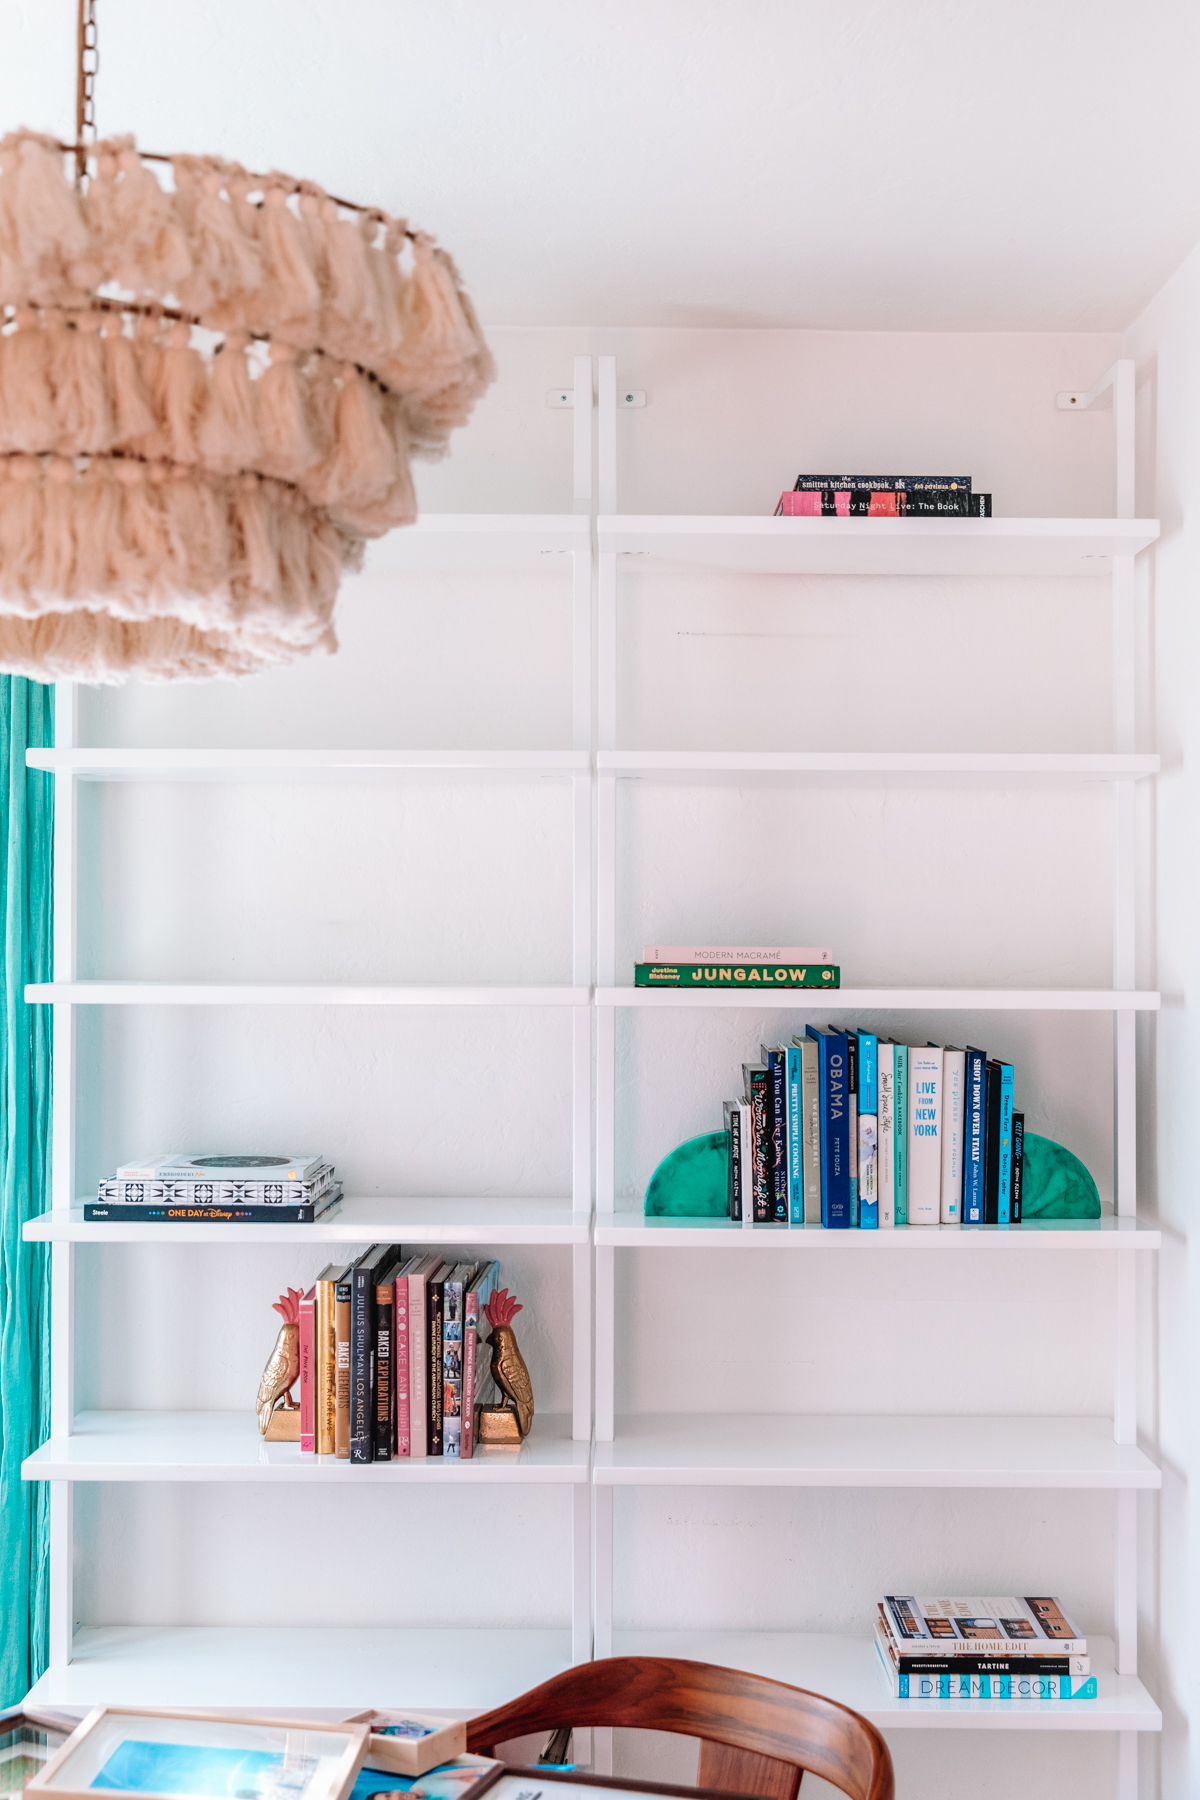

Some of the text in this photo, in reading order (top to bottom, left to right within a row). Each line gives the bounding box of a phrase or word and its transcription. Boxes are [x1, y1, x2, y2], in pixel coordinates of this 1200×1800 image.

[814, 502, 856, 510] Saturday
[890, 503, 915, 511] Live:
[736, 950, 781, 960] MACRAMÉ
[692, 968, 807, 981] JUNGALOW
[774, 1063, 782, 1076] All
[973, 1058, 981, 1082] SHOT
[830, 1054, 843, 1120] OBAMA
[916, 1082, 936, 1094] LIVE
[973, 1084, 981, 1110] DOWN
[754, 1093, 764, 1130] Woven
[879, 1072, 893, 1133] Small Space Style
[915, 1109, 936, 1120] NEW
[913, 1125, 937, 1136] YORK
[972, 1112, 980, 1135] OVER
[754, 1148, 767, 1207] Moonlight
[168, 1209, 187, 1217] ONE
[187, 1209, 203, 1217] DAY
[208, 1208, 232, 1220] Disney
[398, 1300, 406, 1331] COCO
[398, 1334, 407, 1364] CAKE
[338, 1342, 349, 1409] BAKED ELEMENTS
[378, 1330, 389, 1422] BAKED EXPLORATIONS
[399, 1369, 407, 1400] LAND
[356, 1398, 364, 1442] ANGELES
[952, 1642, 1028, 1651] THE HOME EDIT
[921, 1681, 985, 1694] DREAM
[994, 1681, 1057, 1694] DECOR
